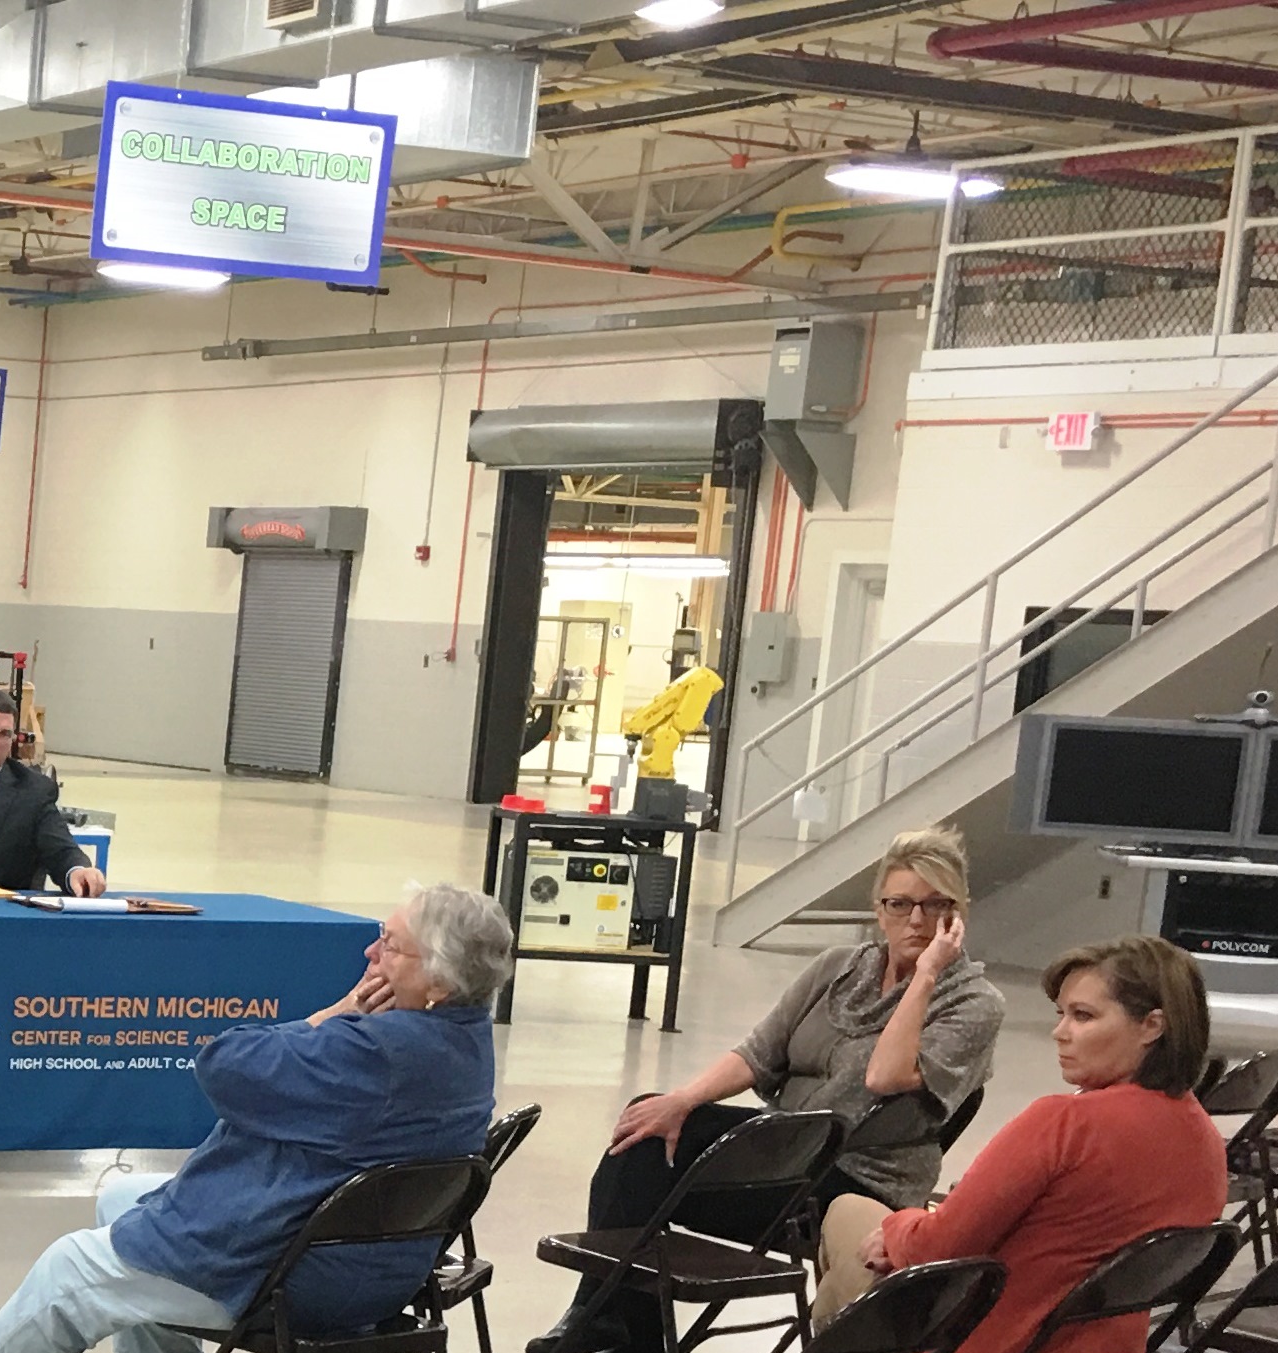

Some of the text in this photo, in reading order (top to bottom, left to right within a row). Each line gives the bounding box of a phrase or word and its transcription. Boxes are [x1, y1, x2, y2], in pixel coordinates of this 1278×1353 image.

[121, 130, 372, 185] COLLABORATION
[191, 197, 288, 234] SPACE
[1054, 413, 1089, 446] EXIT
[1212, 940, 1270, 954] POLYCOM
[13, 996, 280, 1019] SOUTHERN MICHIGAN
[11, 1030, 82, 1046] CENTER
[86, 1034, 110, 1046] FOR
[114, 1030, 189, 1046] SCIENCE
[10, 1057, 42, 1070] HIGH
[45, 1057, 101, 1070] SCHOOL
[104, 1061, 125, 1070] AND
[128, 1057, 172, 1070] ADULT
